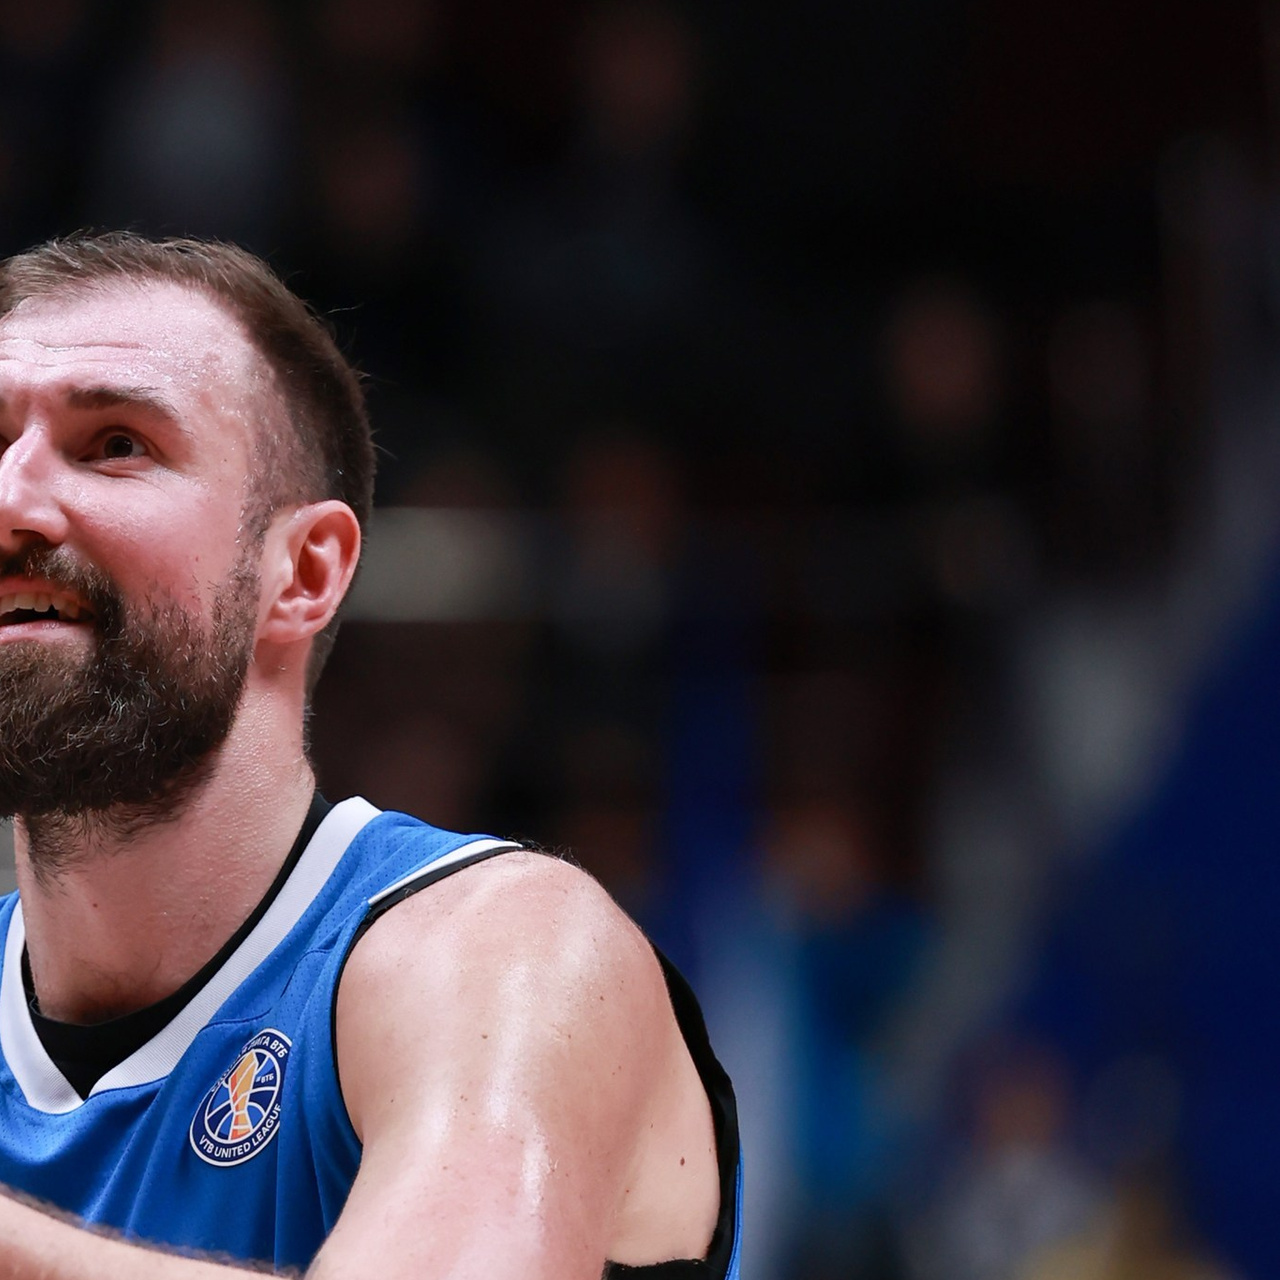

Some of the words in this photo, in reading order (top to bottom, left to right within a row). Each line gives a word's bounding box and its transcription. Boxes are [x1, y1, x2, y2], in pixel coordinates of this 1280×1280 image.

[270, 1039, 287, 1058] ВТБ
[199, 1134, 214, 1153] VTB
[214, 1142, 251, 1158] UNITED
